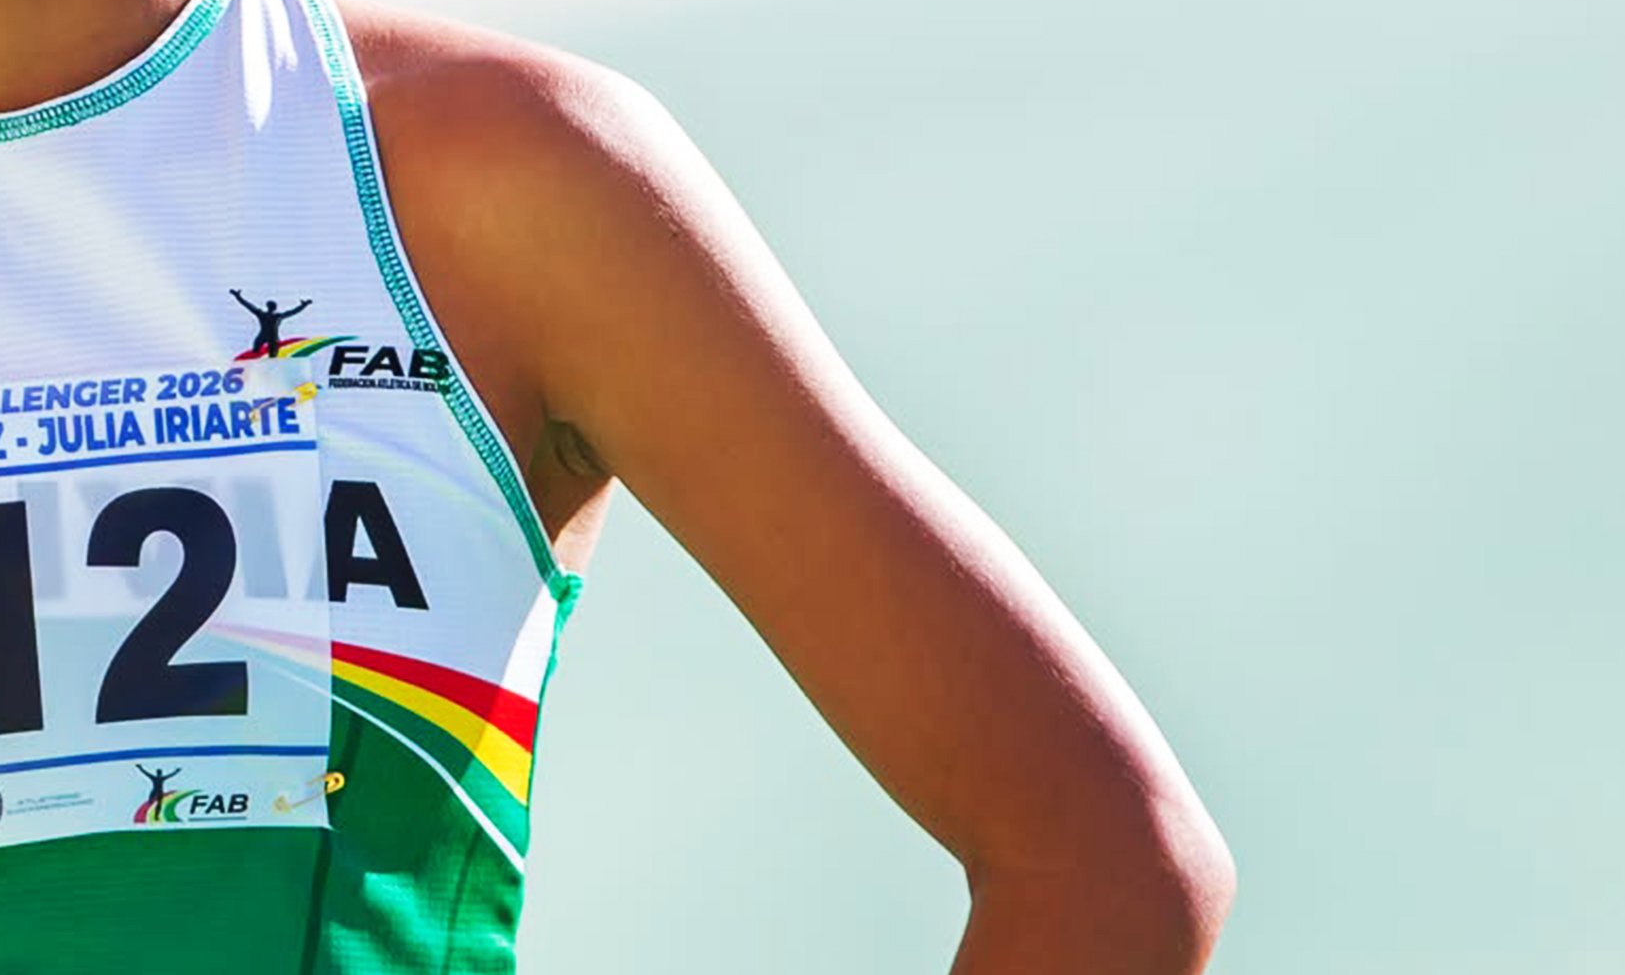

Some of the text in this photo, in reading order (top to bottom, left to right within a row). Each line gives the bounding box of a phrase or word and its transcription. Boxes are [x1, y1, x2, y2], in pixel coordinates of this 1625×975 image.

[328, 346, 450, 380] FAB
[155, 367, 245, 401] 2026
[16, 437, 29, 447] -
[37, 411, 146, 456] JULIA
[153, 396, 301, 445] IRIARTE
[189, 793, 250, 815] FAB
